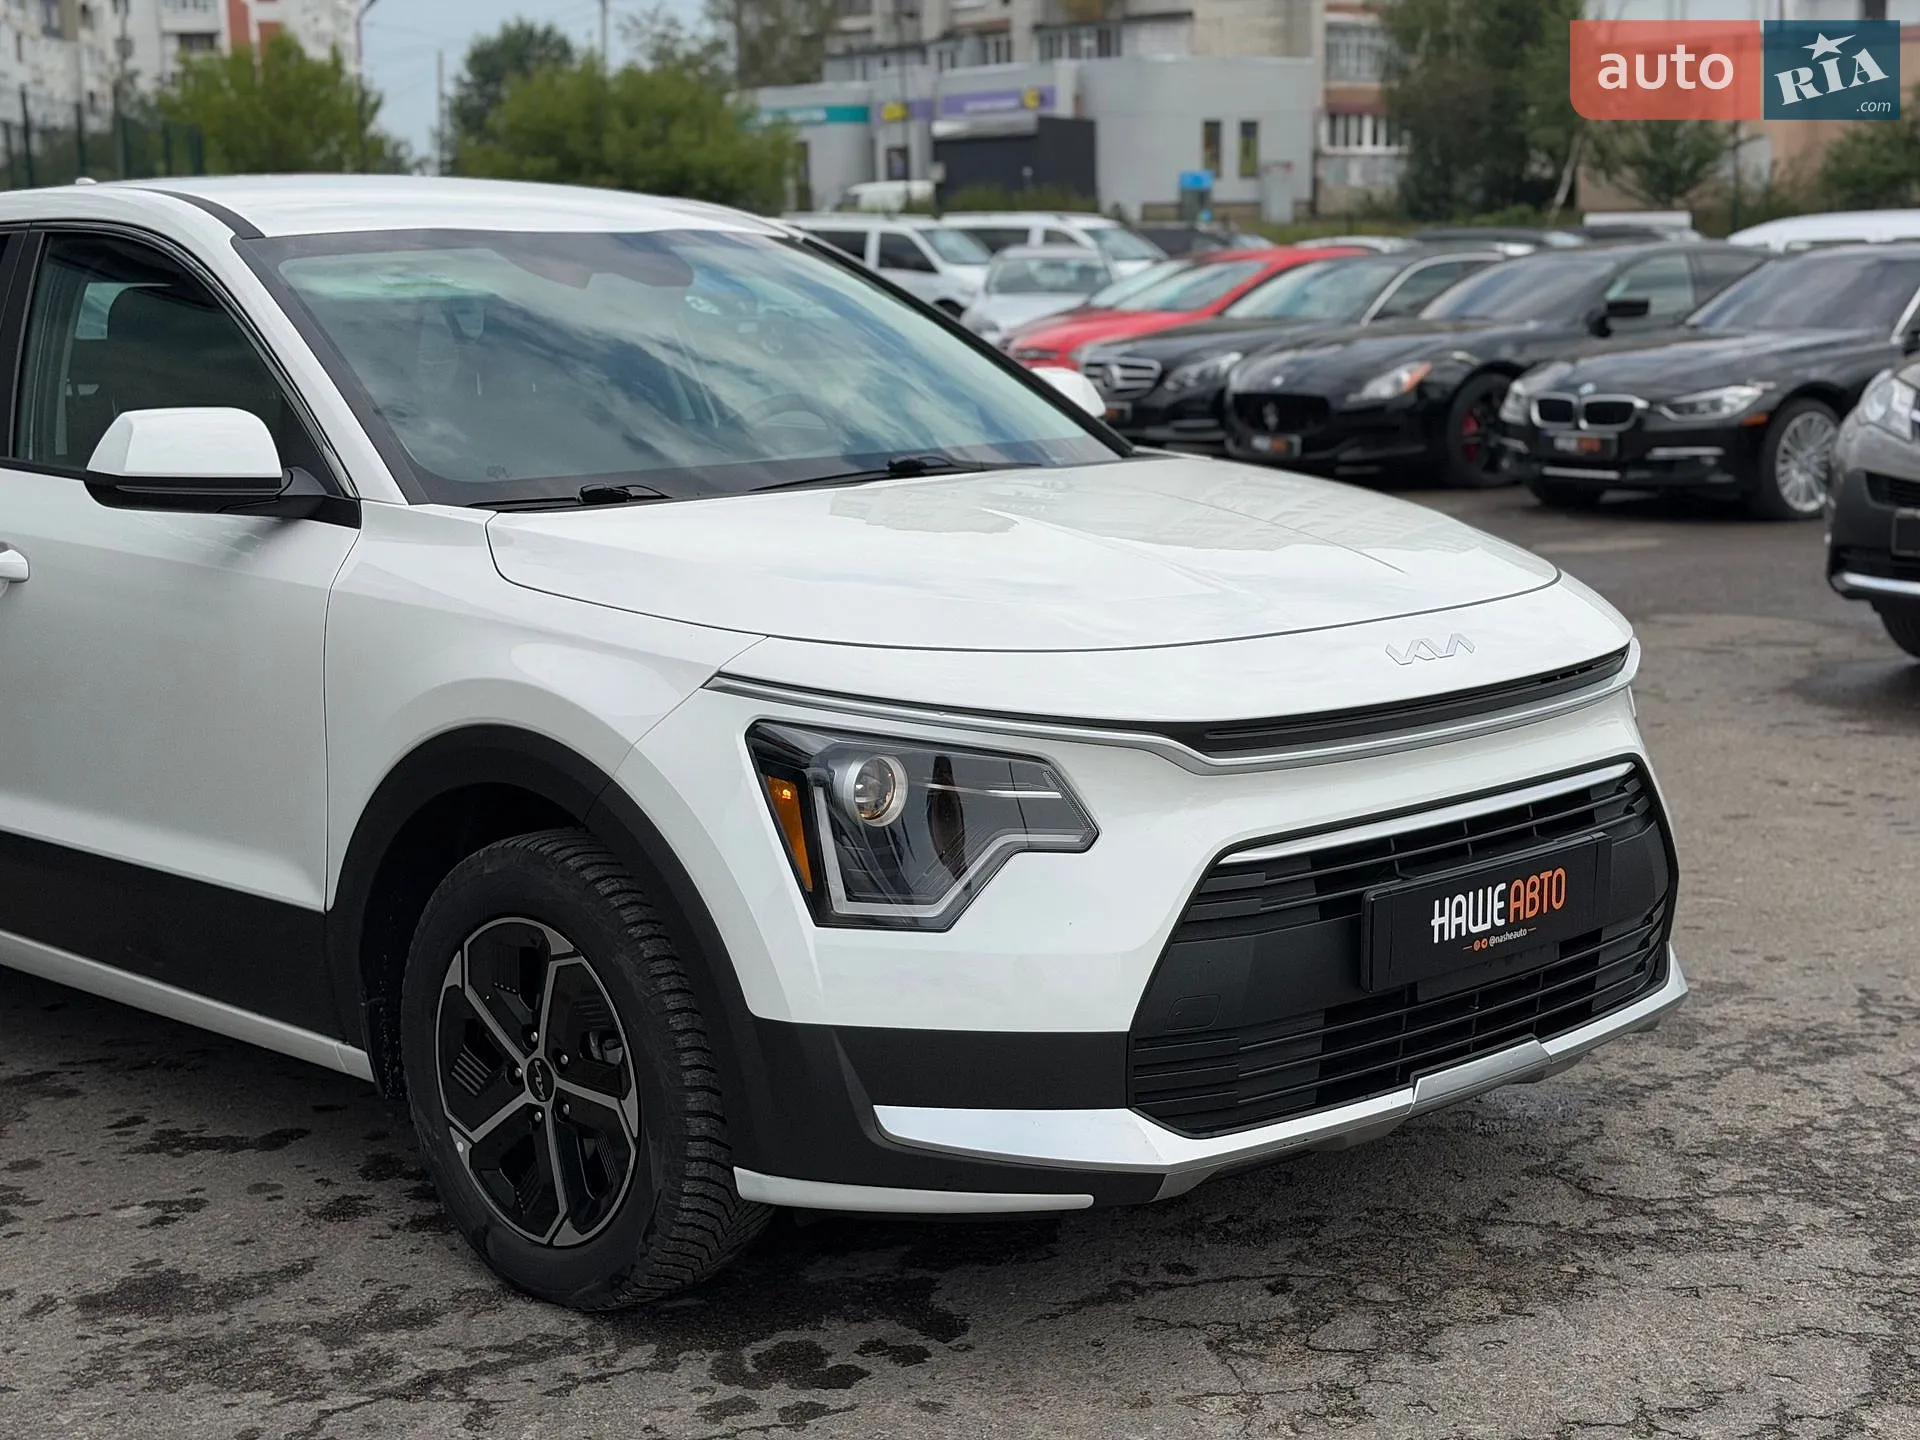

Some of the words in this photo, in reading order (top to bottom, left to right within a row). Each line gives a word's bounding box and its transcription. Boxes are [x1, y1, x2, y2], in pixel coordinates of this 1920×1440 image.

[1431, 882, 1507, 944] НАШЕ
[1509, 867, 1566, 924] АВТО
[1488, 928, 1528, 947] @nasheauto
